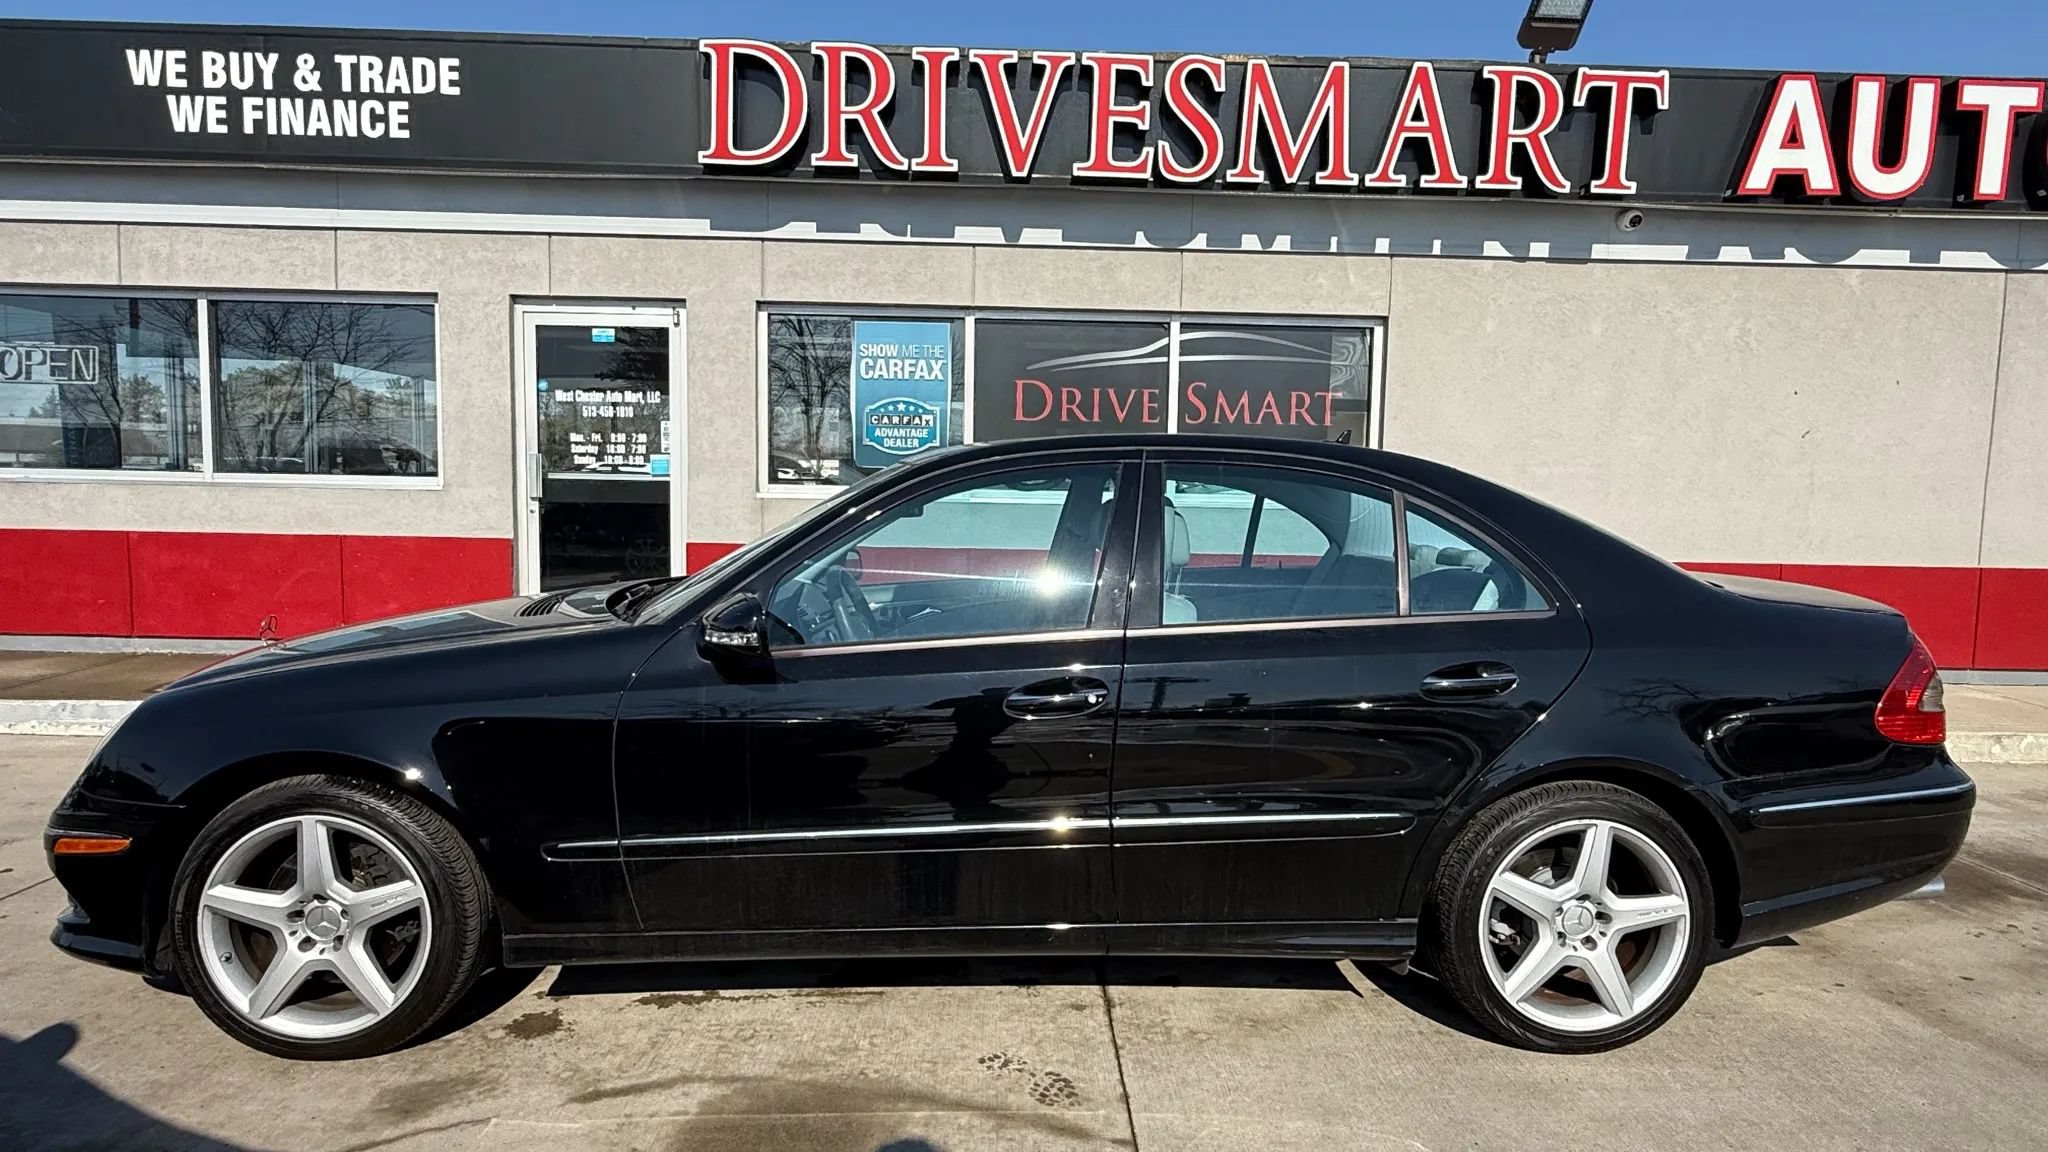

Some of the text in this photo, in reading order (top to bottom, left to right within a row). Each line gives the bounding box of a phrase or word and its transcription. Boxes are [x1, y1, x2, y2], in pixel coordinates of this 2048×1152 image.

[126, 49, 461, 95] WE BUY & TRADE
[166, 95, 411, 138] WE FINANCE
[698, 38, 2048, 202] DRIVESMART AUT
[859, 343, 945, 358] SHOW ME THE
[0, 346, 94, 381] OPEN
[860, 358, 947, 380] CARFAX
[555, 389, 661, 404] West Chester Auto Mart, LLC
[1014, 379, 1343, 427] DRIVE SMART
[869, 414, 934, 426] CARFAX
[874, 428, 929, 438] ADVANTAGE
[570, 444, 599, 455] Saturday
[883, 438, 919, 448] DEALER
